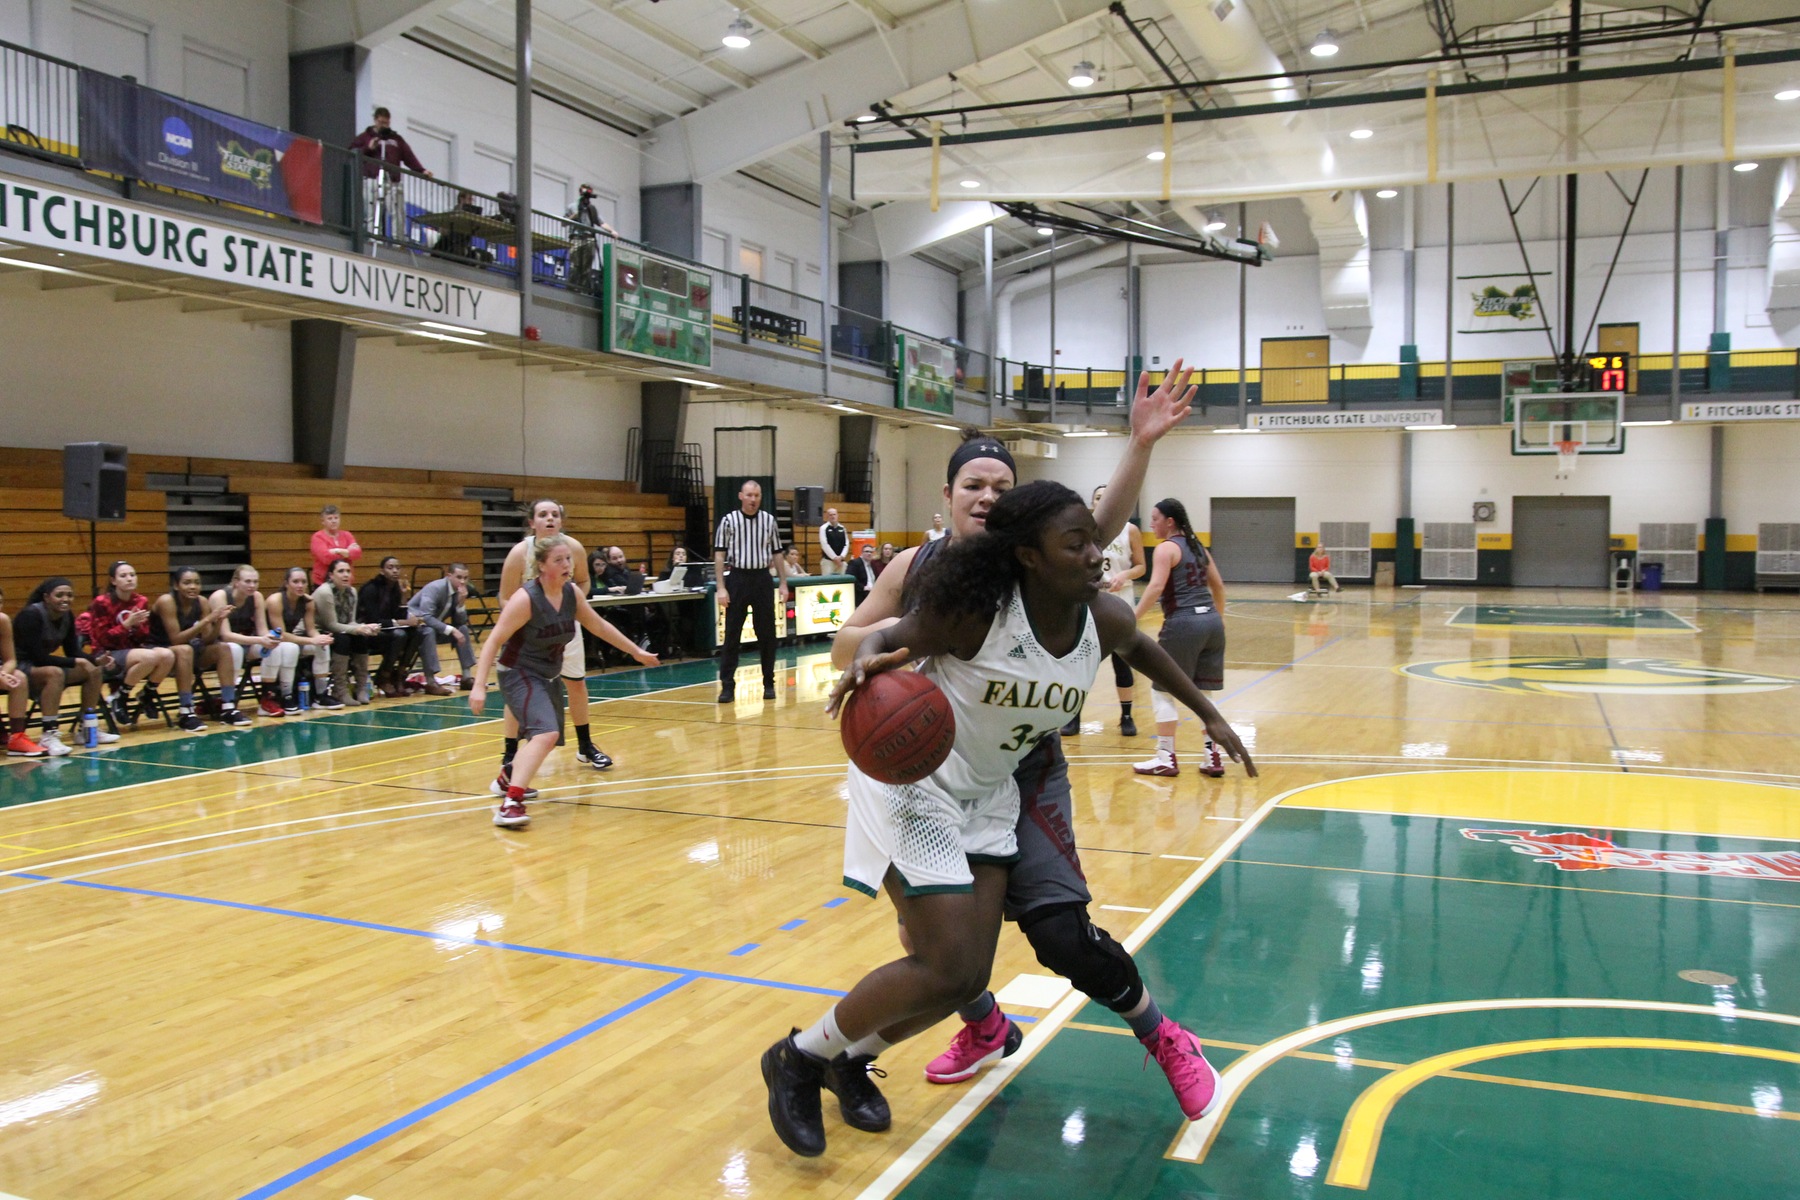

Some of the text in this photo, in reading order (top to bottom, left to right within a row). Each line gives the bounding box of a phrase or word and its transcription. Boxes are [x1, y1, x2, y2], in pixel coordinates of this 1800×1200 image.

[224, 235, 313, 287] STATE
[330, 258, 482, 320] UNIVERSITY
[1707, 405, 1781, 417] FITCHBURG
[1269, 412, 1437, 426] FITCHBURG STATE UNIVERSITY
